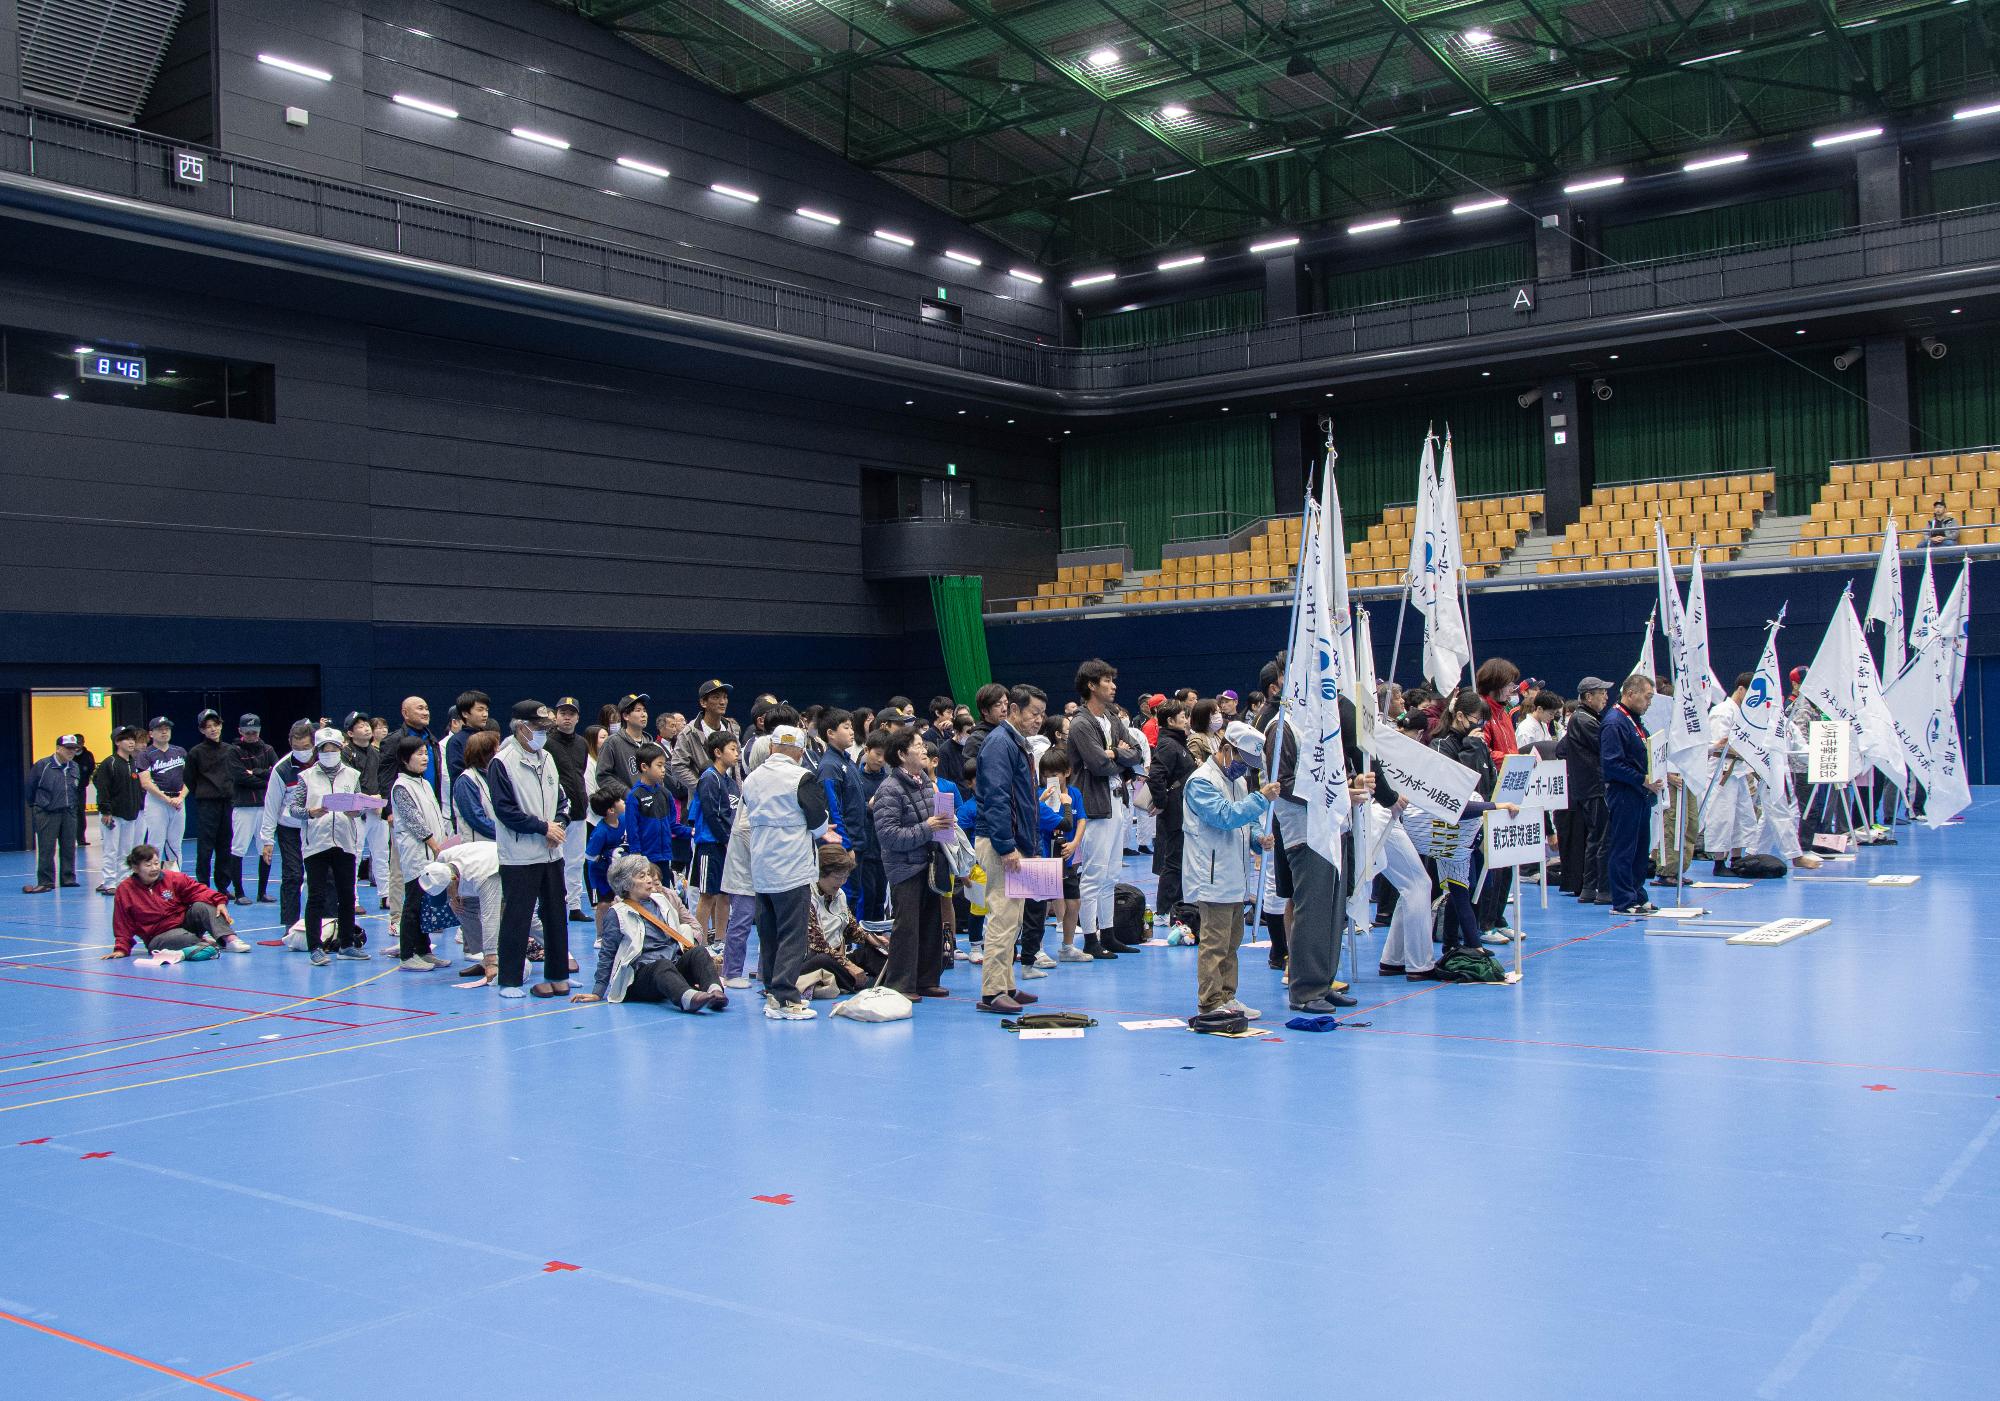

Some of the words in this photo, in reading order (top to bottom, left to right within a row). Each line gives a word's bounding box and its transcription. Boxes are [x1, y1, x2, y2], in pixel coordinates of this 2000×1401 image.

[178, 153, 204, 182] 西
[1513, 289, 1531, 309] A
[1493, 823, 1541, 850] 軟式野球連盟
